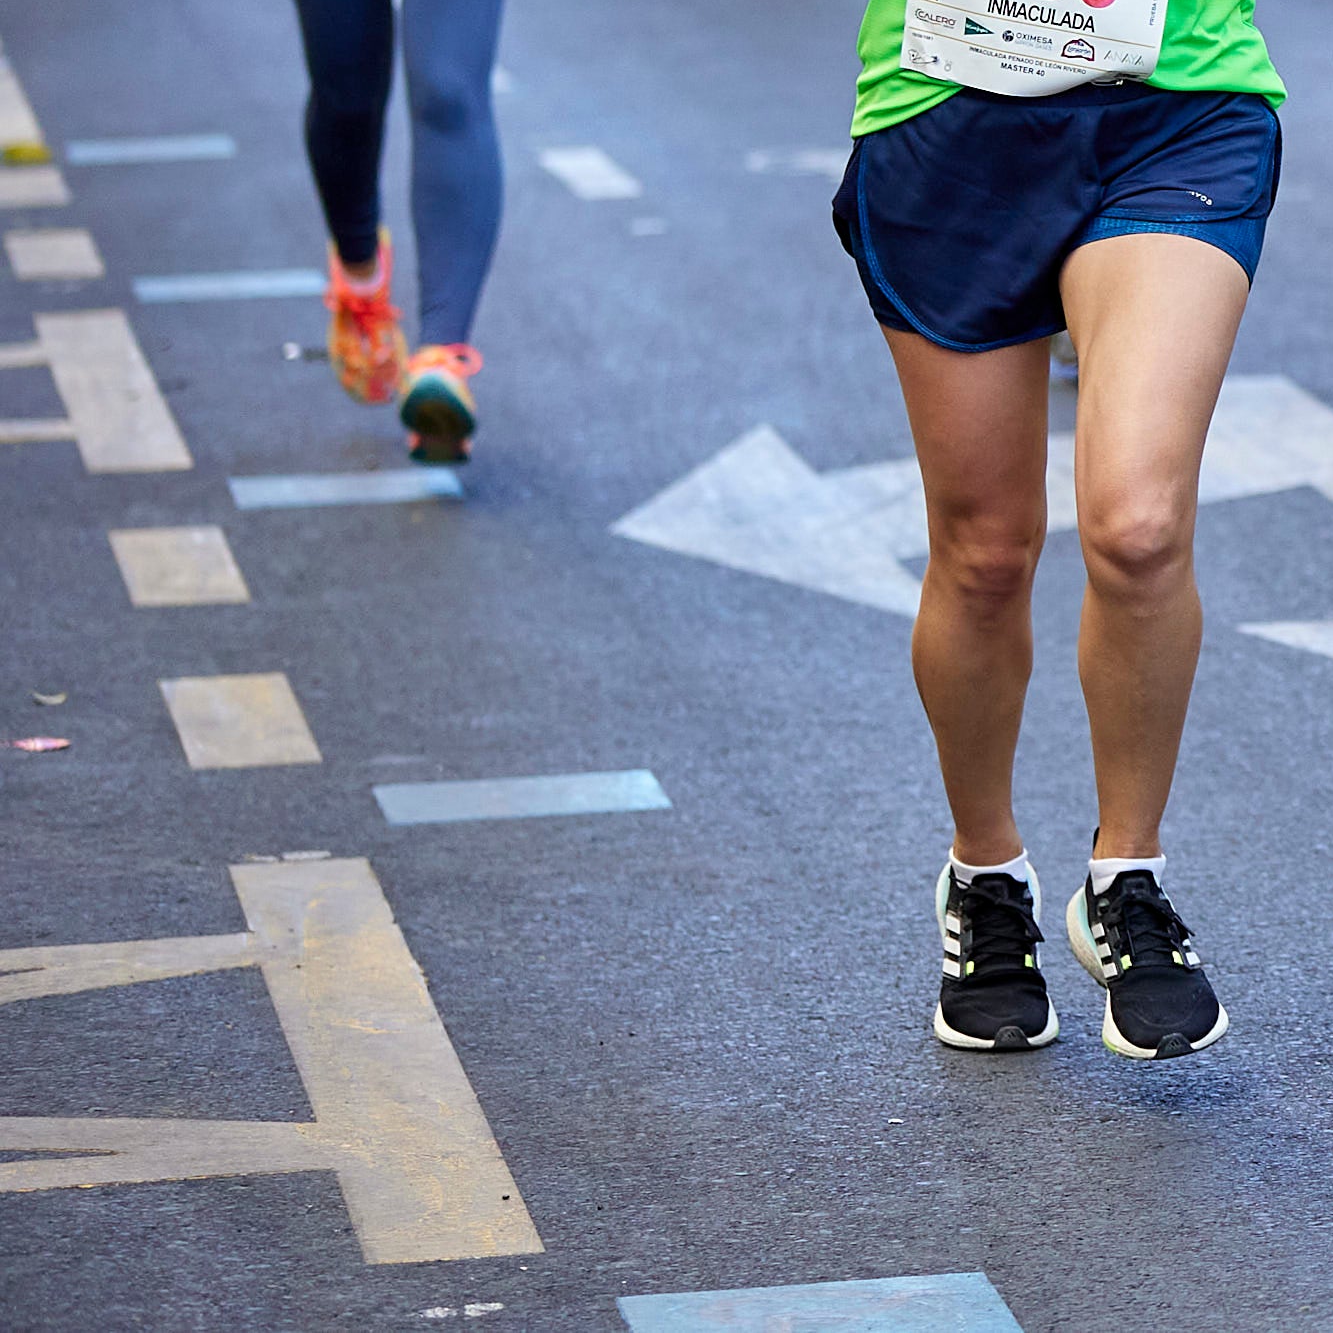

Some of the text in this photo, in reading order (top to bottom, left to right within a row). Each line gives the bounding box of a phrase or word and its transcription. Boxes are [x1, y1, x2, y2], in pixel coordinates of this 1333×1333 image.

[917, 10, 956, 26] CALERO
[1016, 32, 1053, 45] OXIMESA
[969, 45, 1007, 60] INMACULADA
[1063, 65, 1087, 74] RIVERO
[1000, 62, 1046, 77] MASTER 40
